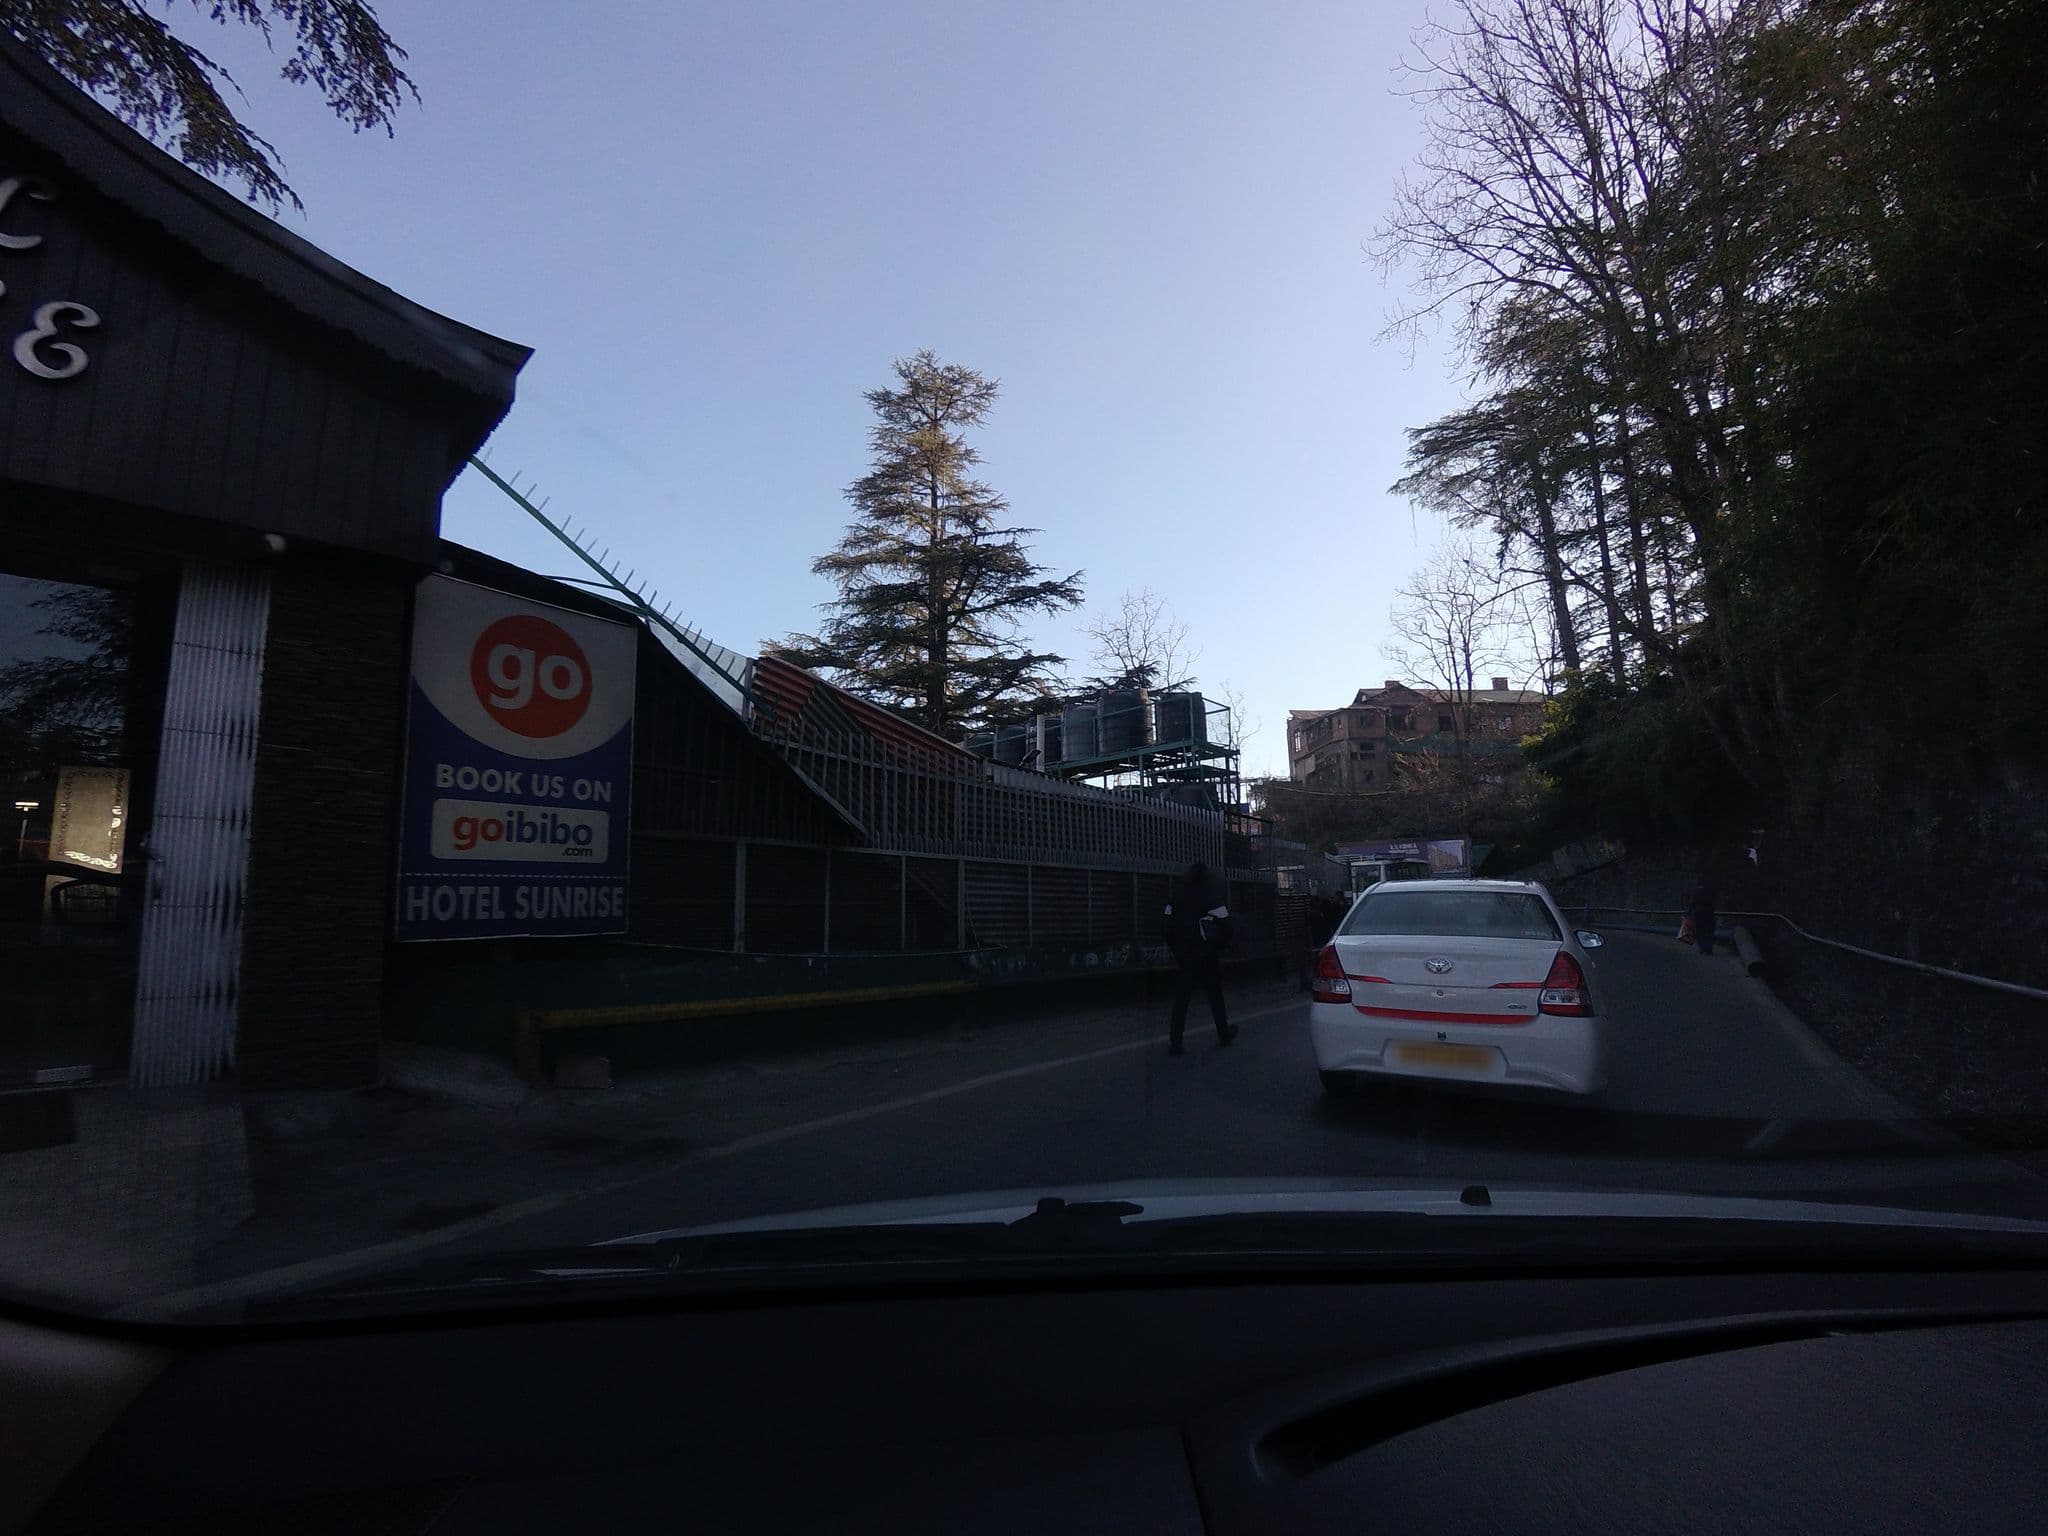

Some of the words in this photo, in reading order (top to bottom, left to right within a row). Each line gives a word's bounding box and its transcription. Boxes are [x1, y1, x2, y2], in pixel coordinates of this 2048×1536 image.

[487, 643, 583, 710] go
[435, 763, 523, 795] BOOK
[531, 773, 565, 799] US
[573, 777, 612, 802] ON
[453, 810, 593, 851] goibibo
[406, 885, 505, 922] HOTEL
[515, 885, 625, 919] SUNRISE
